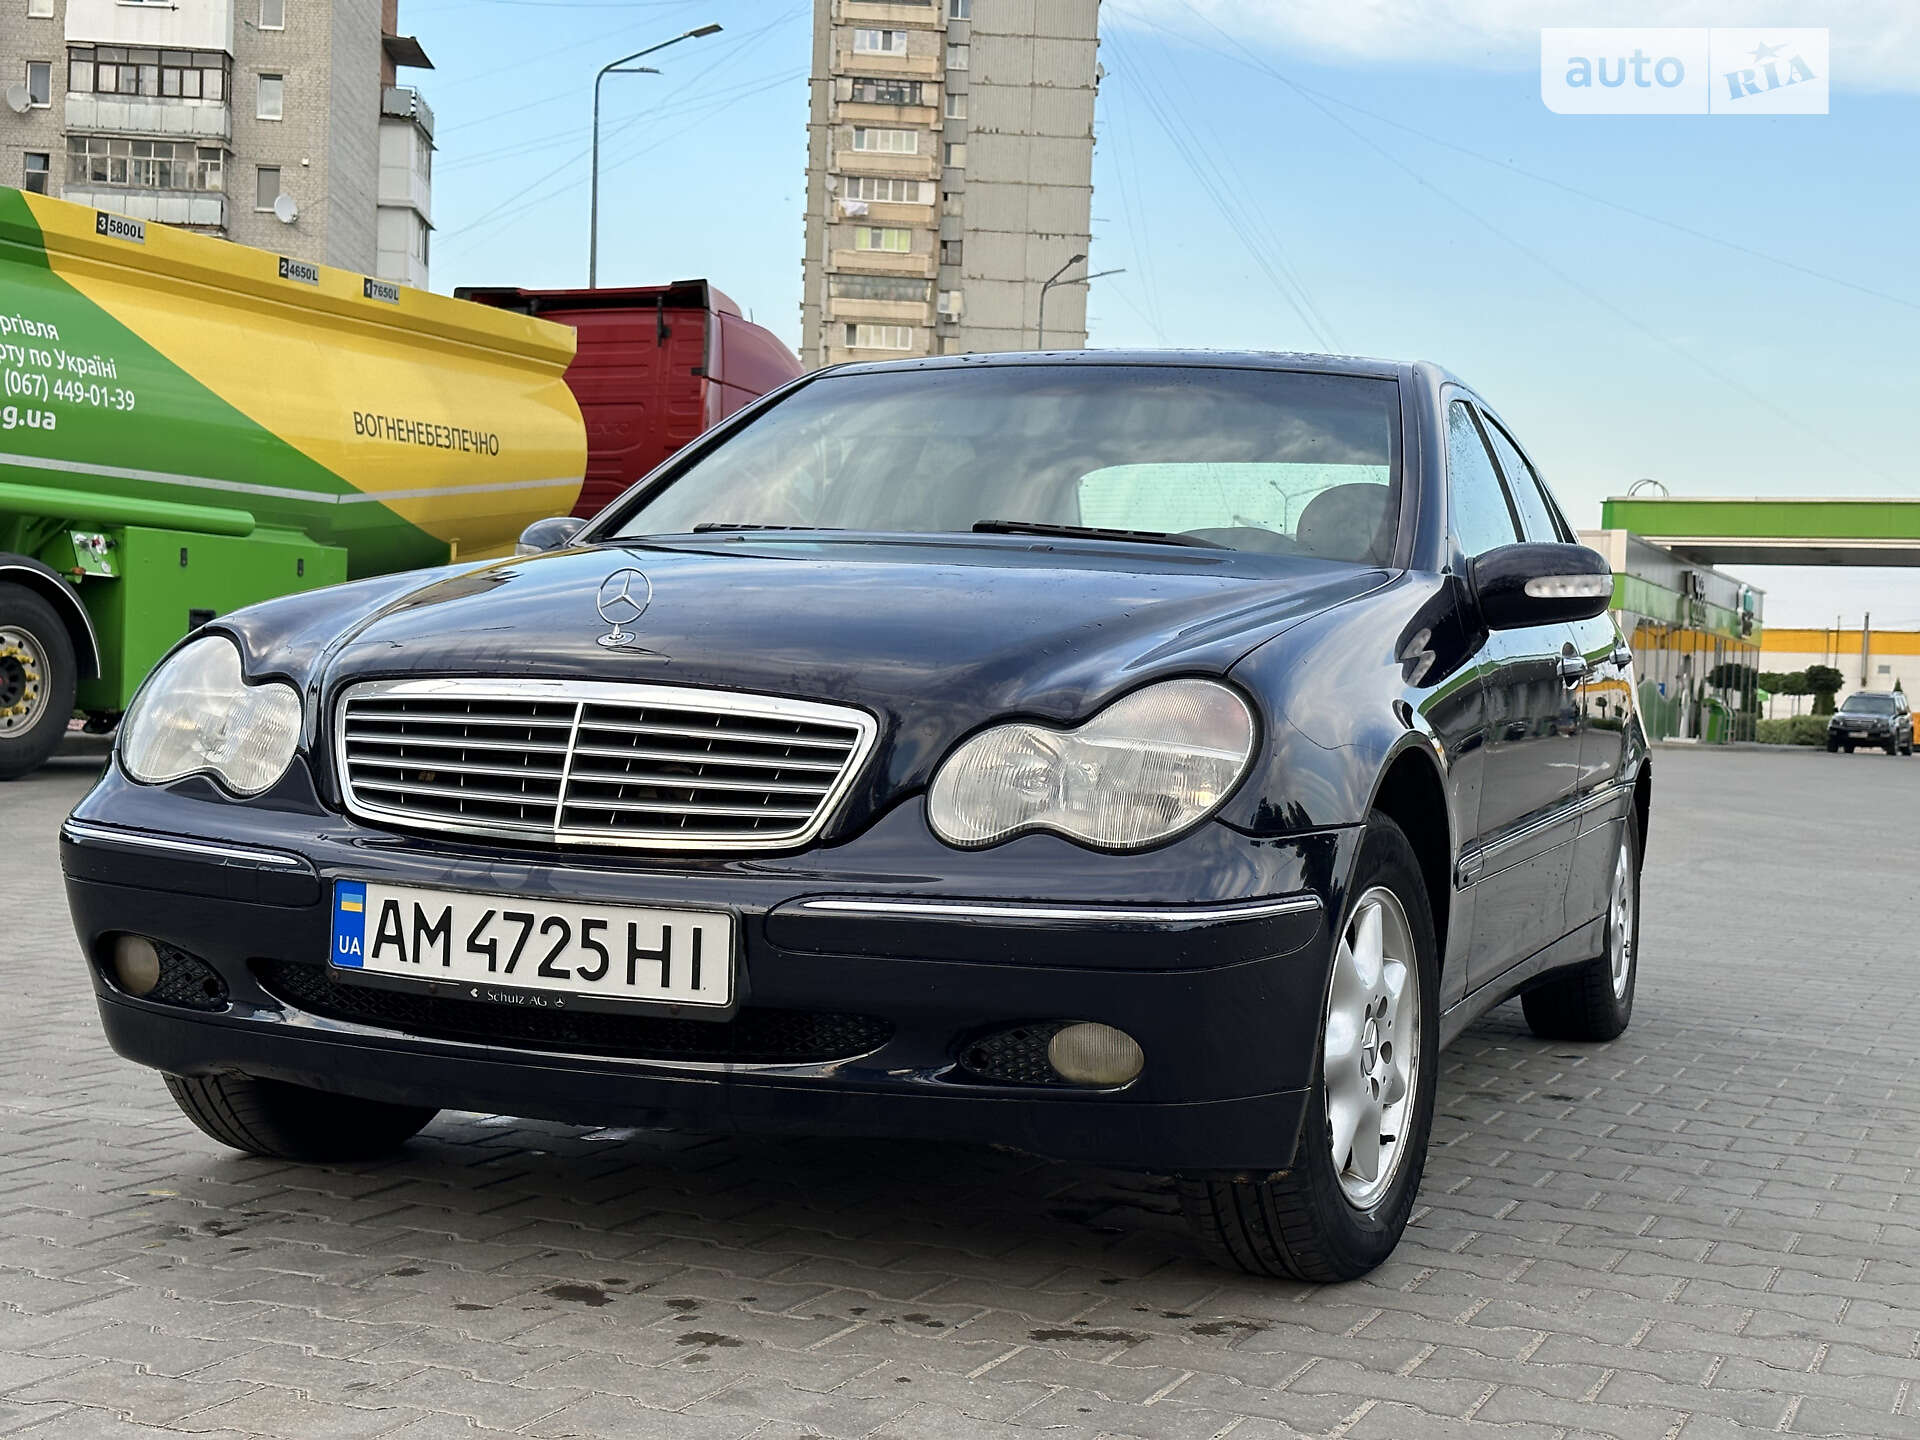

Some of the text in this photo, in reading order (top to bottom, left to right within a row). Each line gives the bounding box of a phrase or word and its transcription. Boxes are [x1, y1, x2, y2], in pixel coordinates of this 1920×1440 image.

[98, 216, 144, 239] 3 5800L
[280, 261, 318, 281] 2 4650L
[373, 284, 399, 301] 7650L
[29, 348, 52, 368] по
[53, 348, 118, 380] Україні
[4, 367, 135, 411] (067) 449-01-39
[353, 411, 500, 457] ВОГНЕНЕБЕЗПЕЧНО
[339, 935, 361, 956] UA
[371, 899, 453, 967] AM
[466, 909, 610, 982] 4725
[529, 995, 547, 1007] AG
